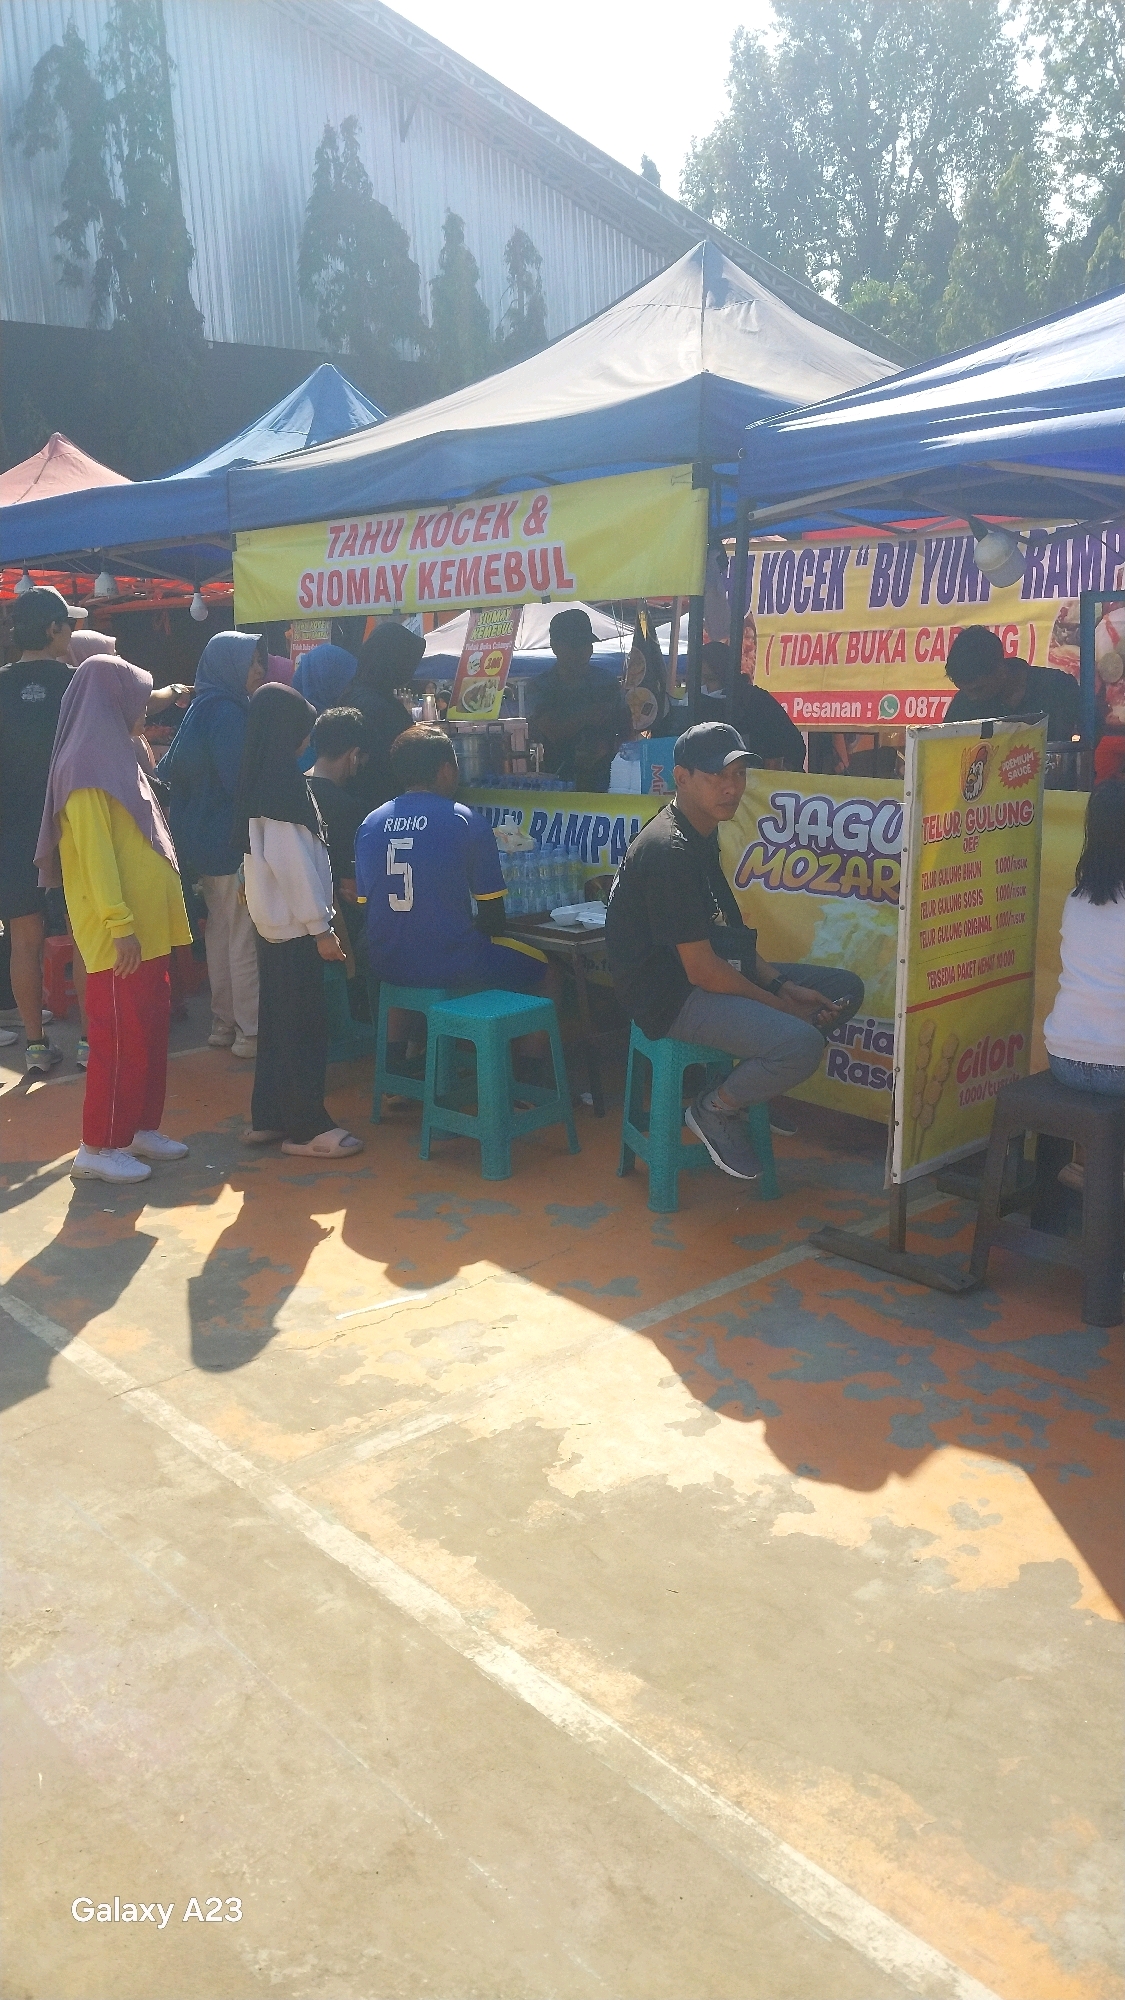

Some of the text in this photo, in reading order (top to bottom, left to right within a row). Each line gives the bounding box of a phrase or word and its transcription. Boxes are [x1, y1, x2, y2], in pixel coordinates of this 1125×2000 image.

[327, 494, 549, 559] TAHU KOCEK &
[300, 546, 574, 608] SIOMAY KEMEBUL
[758, 546, 851, 614] KOCEK
[780, 631, 842, 666] TIDAK
[845, 629, 906, 664] BUKA
[915, 625, 1018, 662] CAG
[793, 698, 861, 718] Pesanan
[905, 697, 951, 717] 0877
[1002, 752, 1034, 771] PREMIUM
[1008, 764, 1031, 781] SAUCE
[384, 816, 428, 832] RIDHO
[922, 800, 1033, 844] TELUR GULUNG
[387, 838, 414, 911] 5
[737, 843, 899, 902] MOZAR
[922, 871, 937, 891] TELUR
[939, 865, 961, 886] GULUNG
[920, 900, 936, 920] TELUR
[938, 893, 961, 915] GULUNG
[964, 889, 983, 909] SOSIS
[920, 928, 936, 949] TELUR
[938, 922, 962, 944] GULUNG
[964, 915, 992, 937] ORIGINAL
[927, 966, 955, 990] TERSEDIA
[957, 960, 976, 981] PAKET
